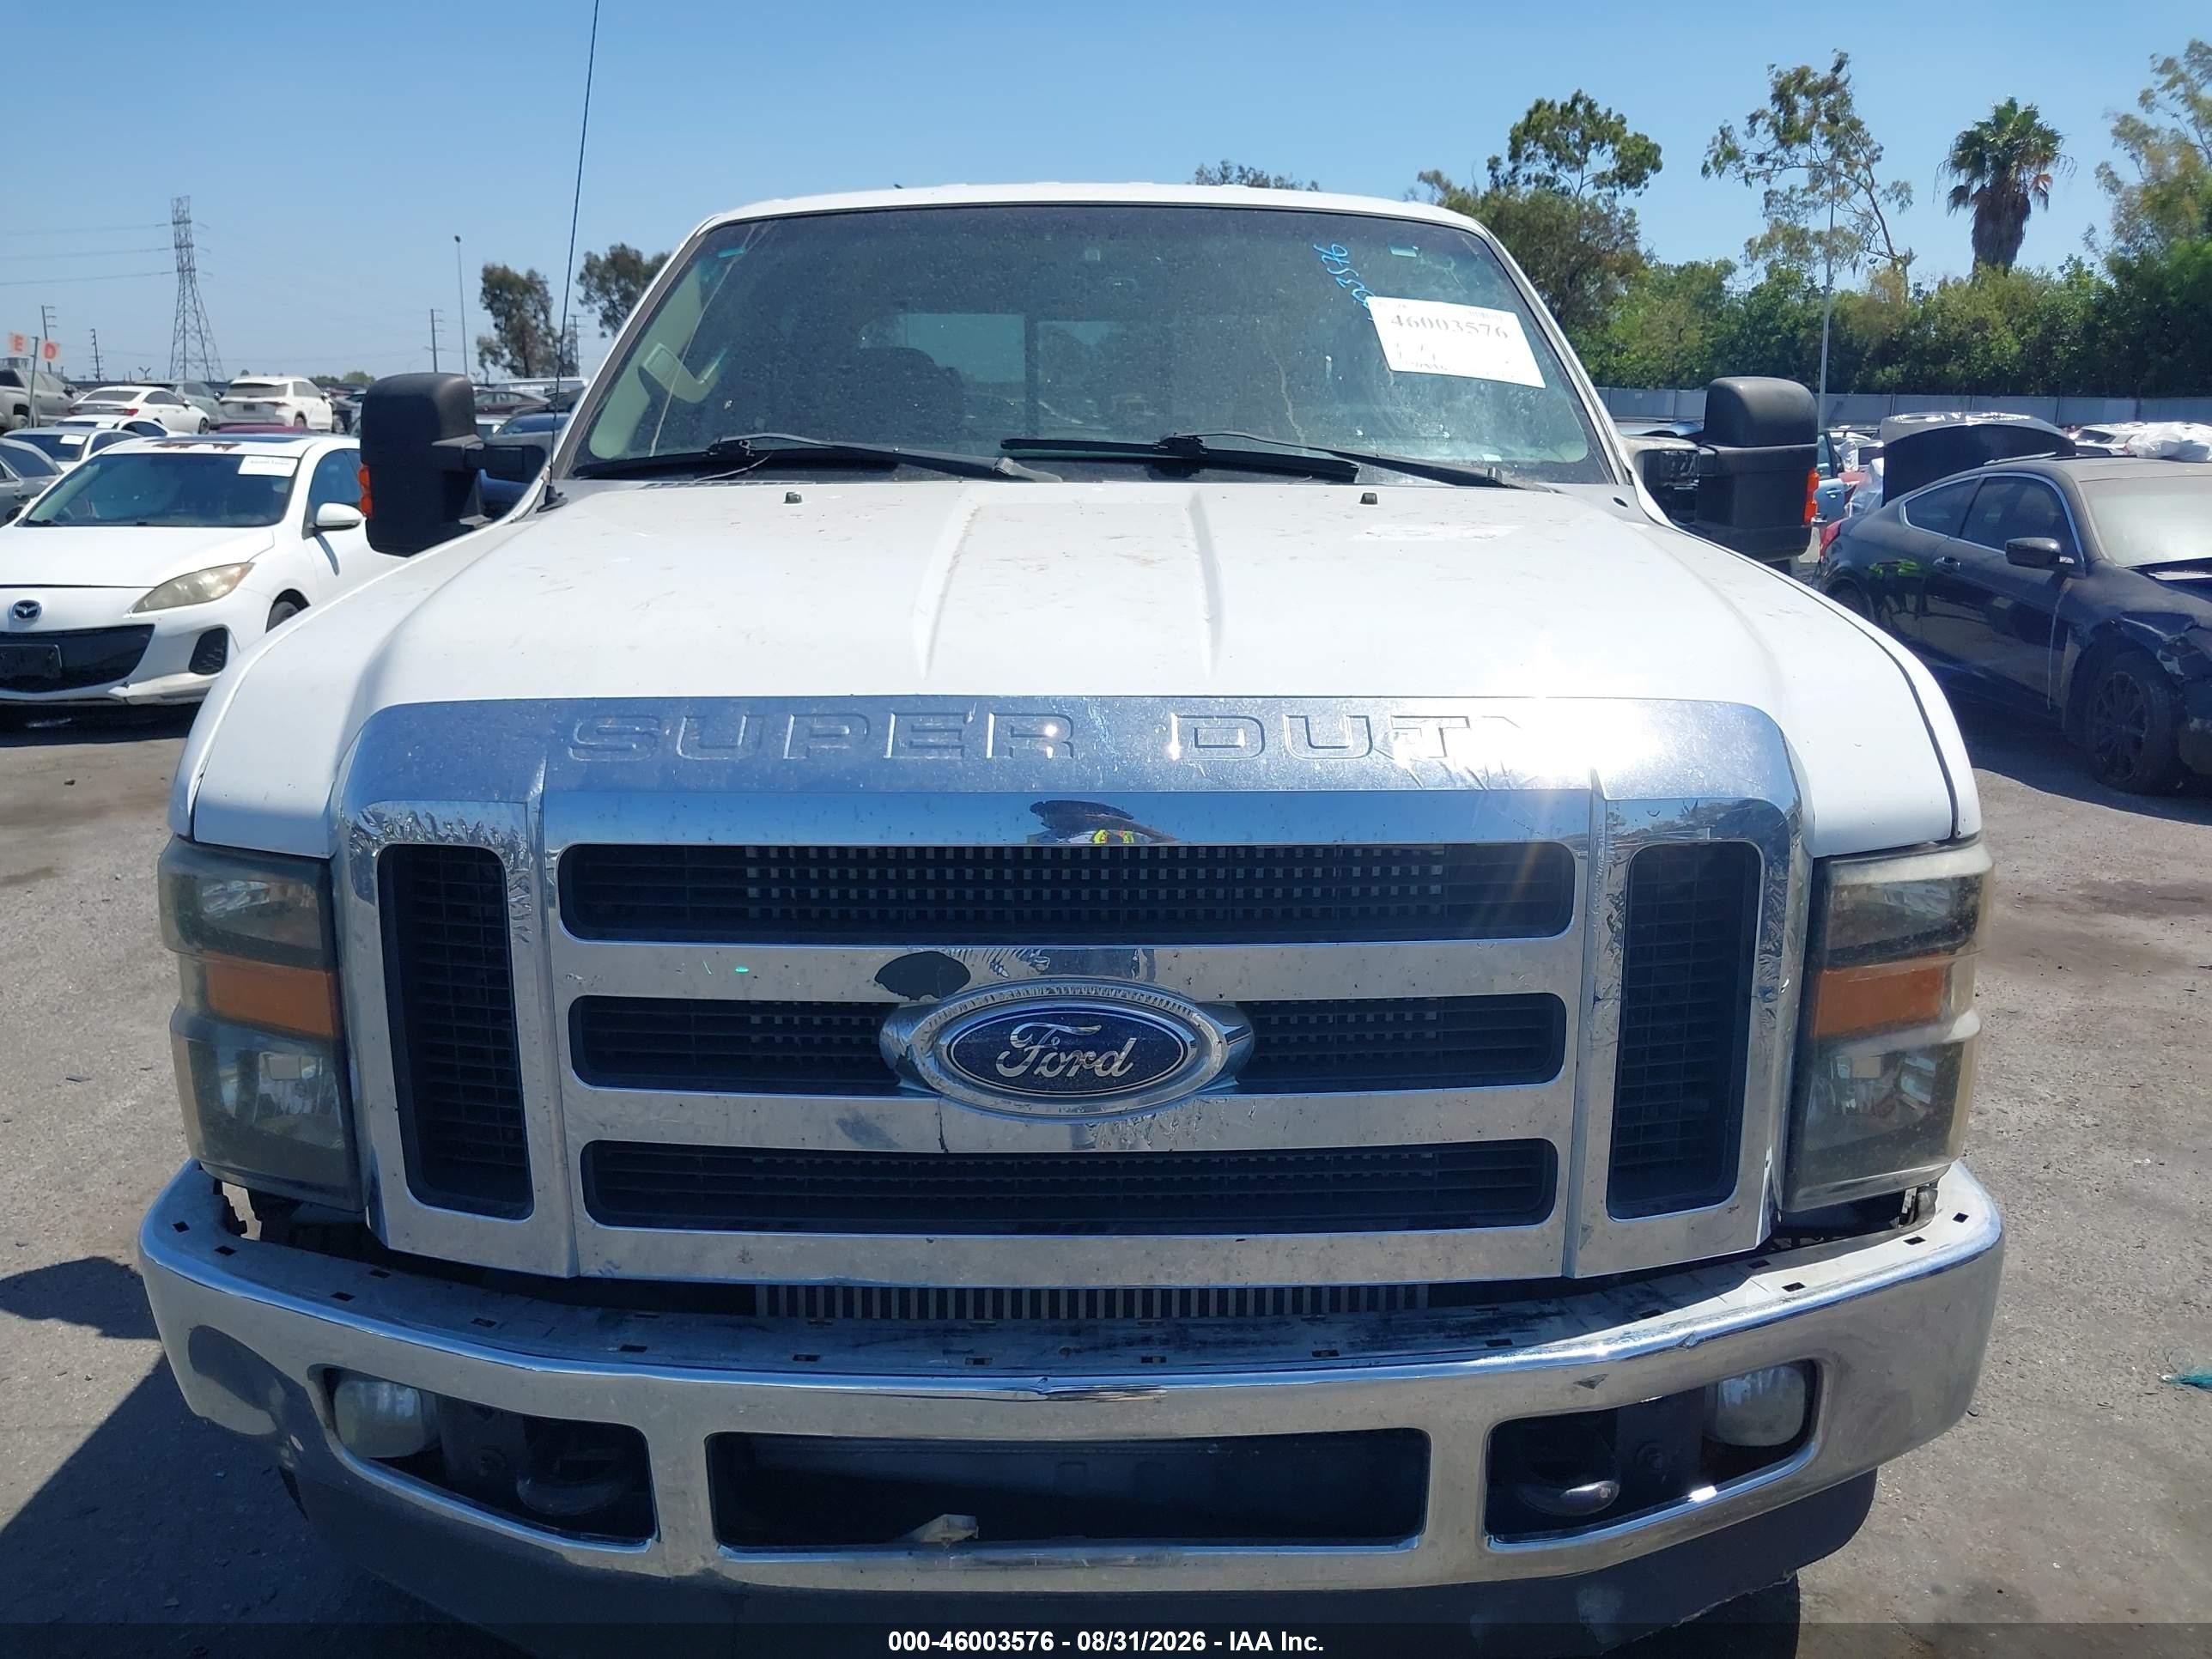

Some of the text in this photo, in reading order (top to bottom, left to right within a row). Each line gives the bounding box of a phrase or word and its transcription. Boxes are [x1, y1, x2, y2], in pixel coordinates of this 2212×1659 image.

[1390, 314, 1509, 339] 46003576
[568, 712, 1533, 763] SUPER DUT
[996, 1022, 1137, 1079] Ford
